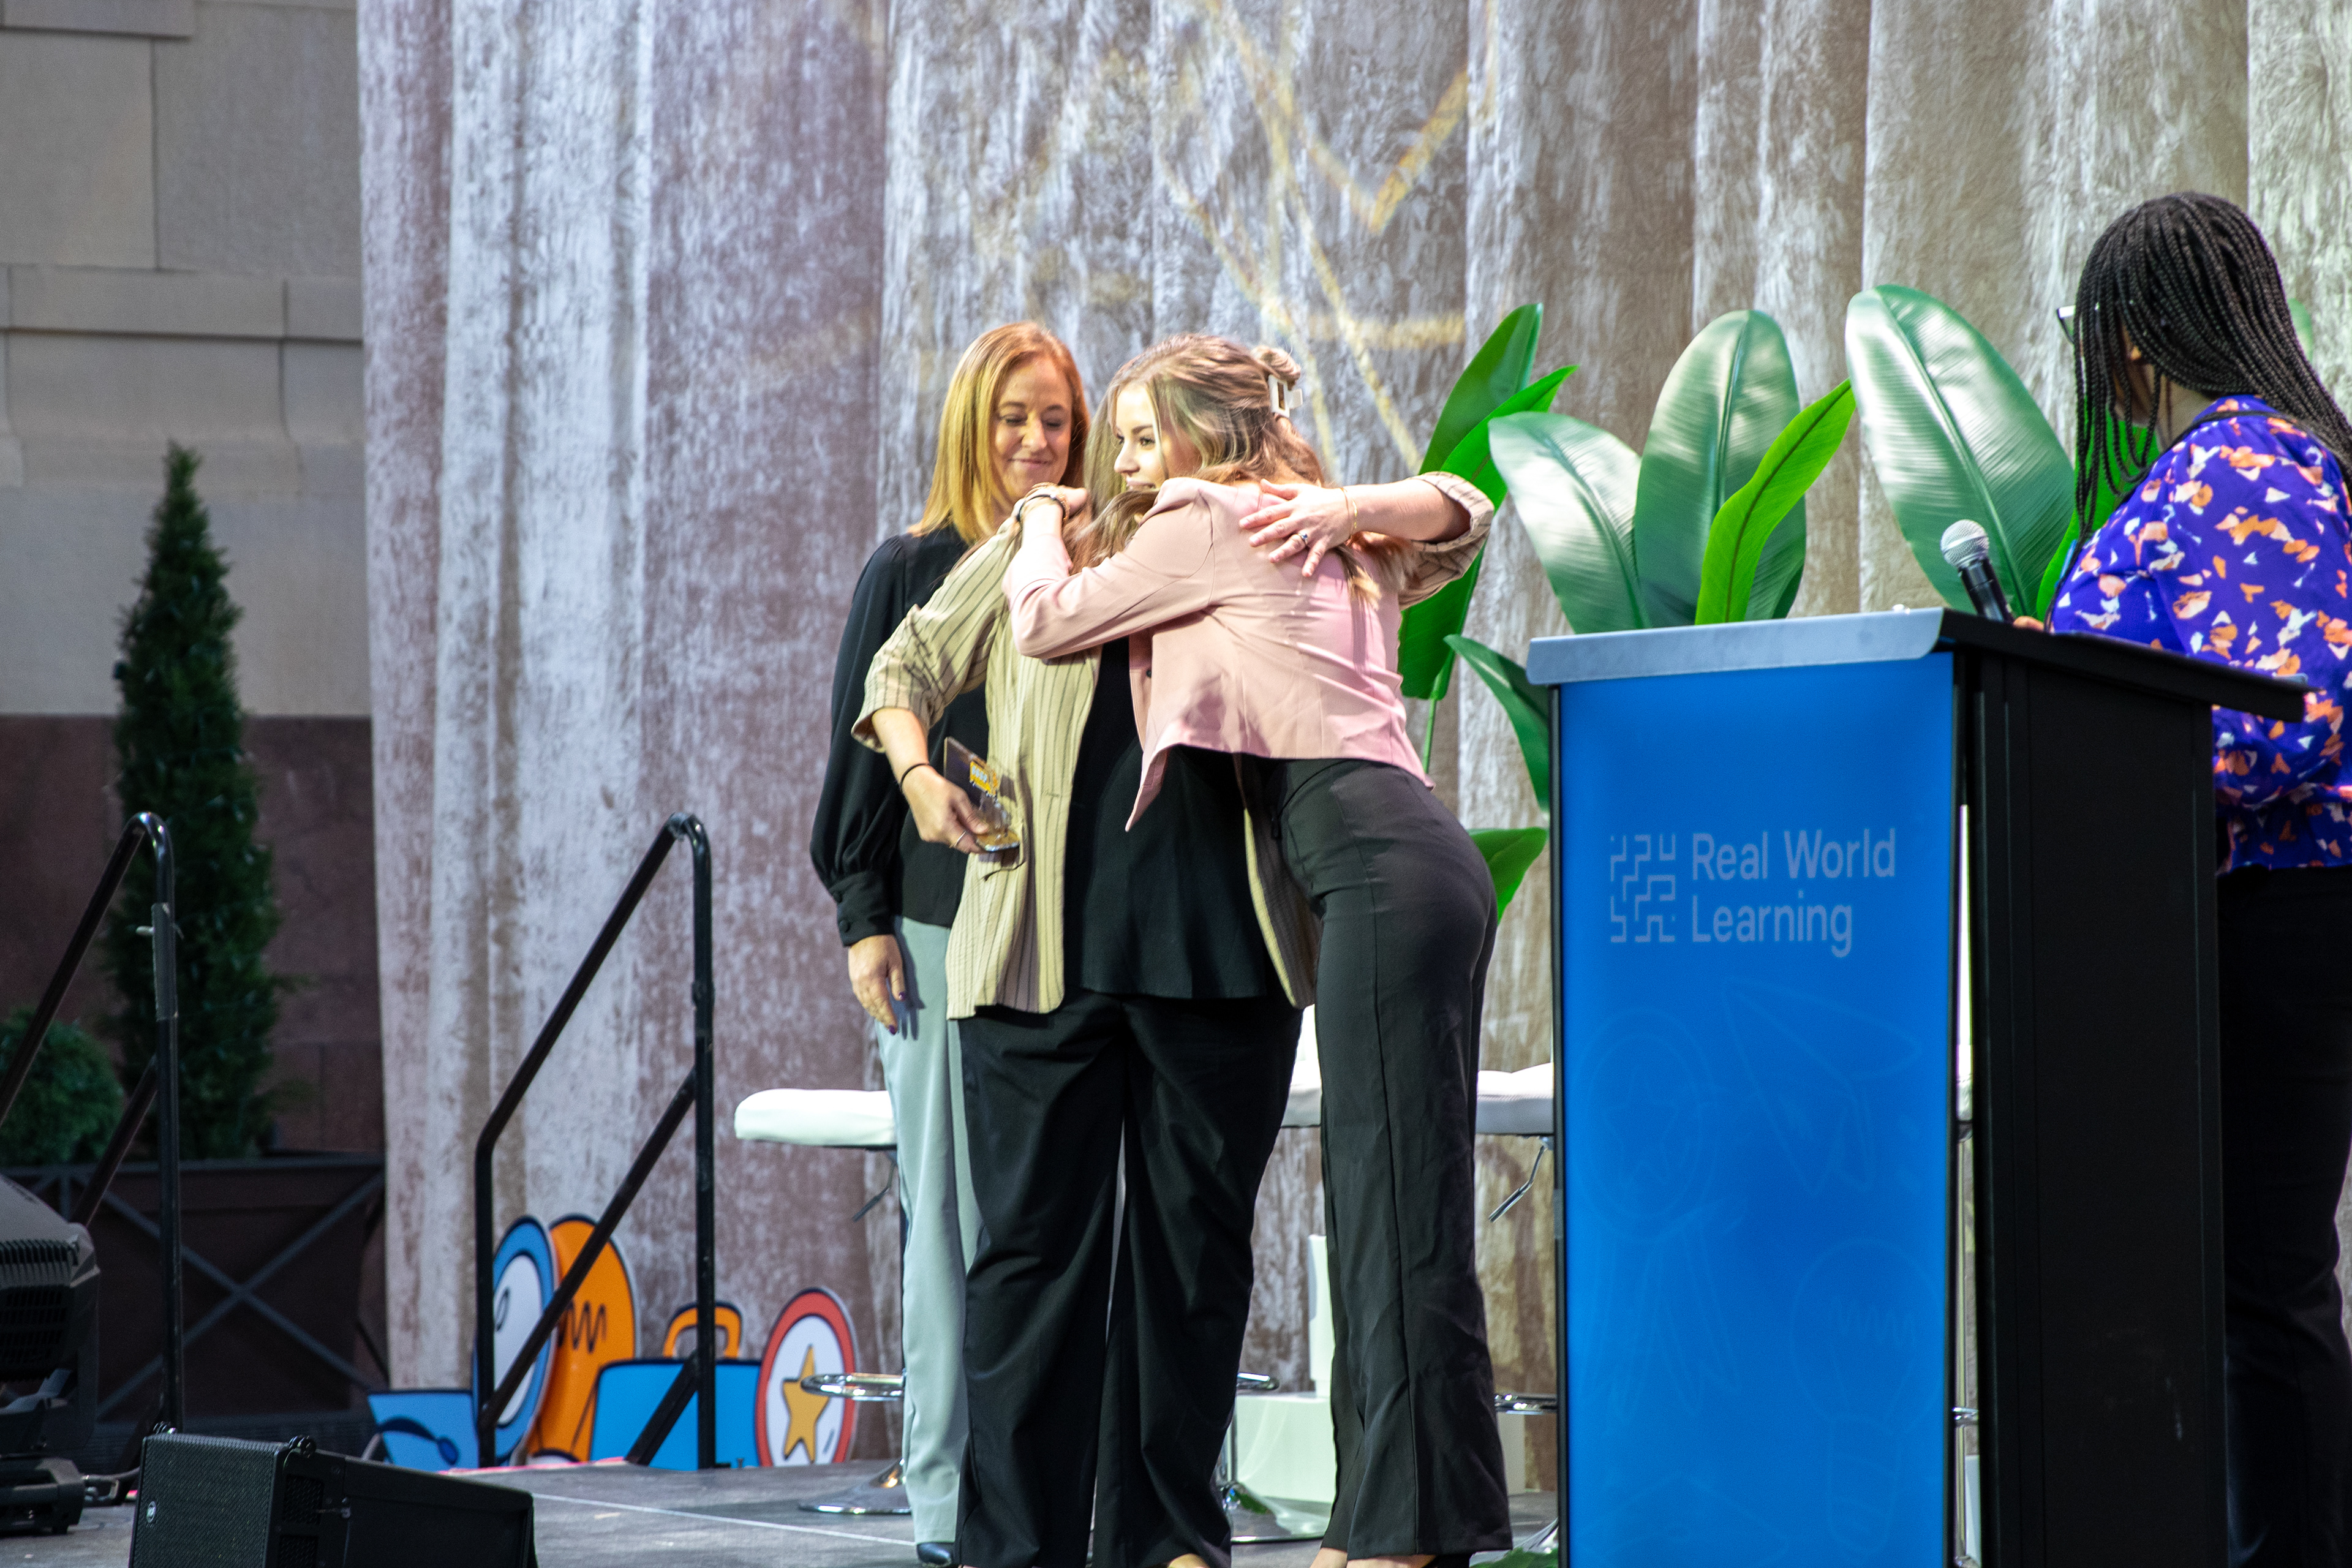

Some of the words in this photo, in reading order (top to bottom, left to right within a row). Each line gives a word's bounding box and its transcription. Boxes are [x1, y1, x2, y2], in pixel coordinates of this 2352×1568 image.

[1692, 831, 1768, 880] Real
[1784, 828, 1895, 879] World
[1692, 889, 1852, 958] Learning
